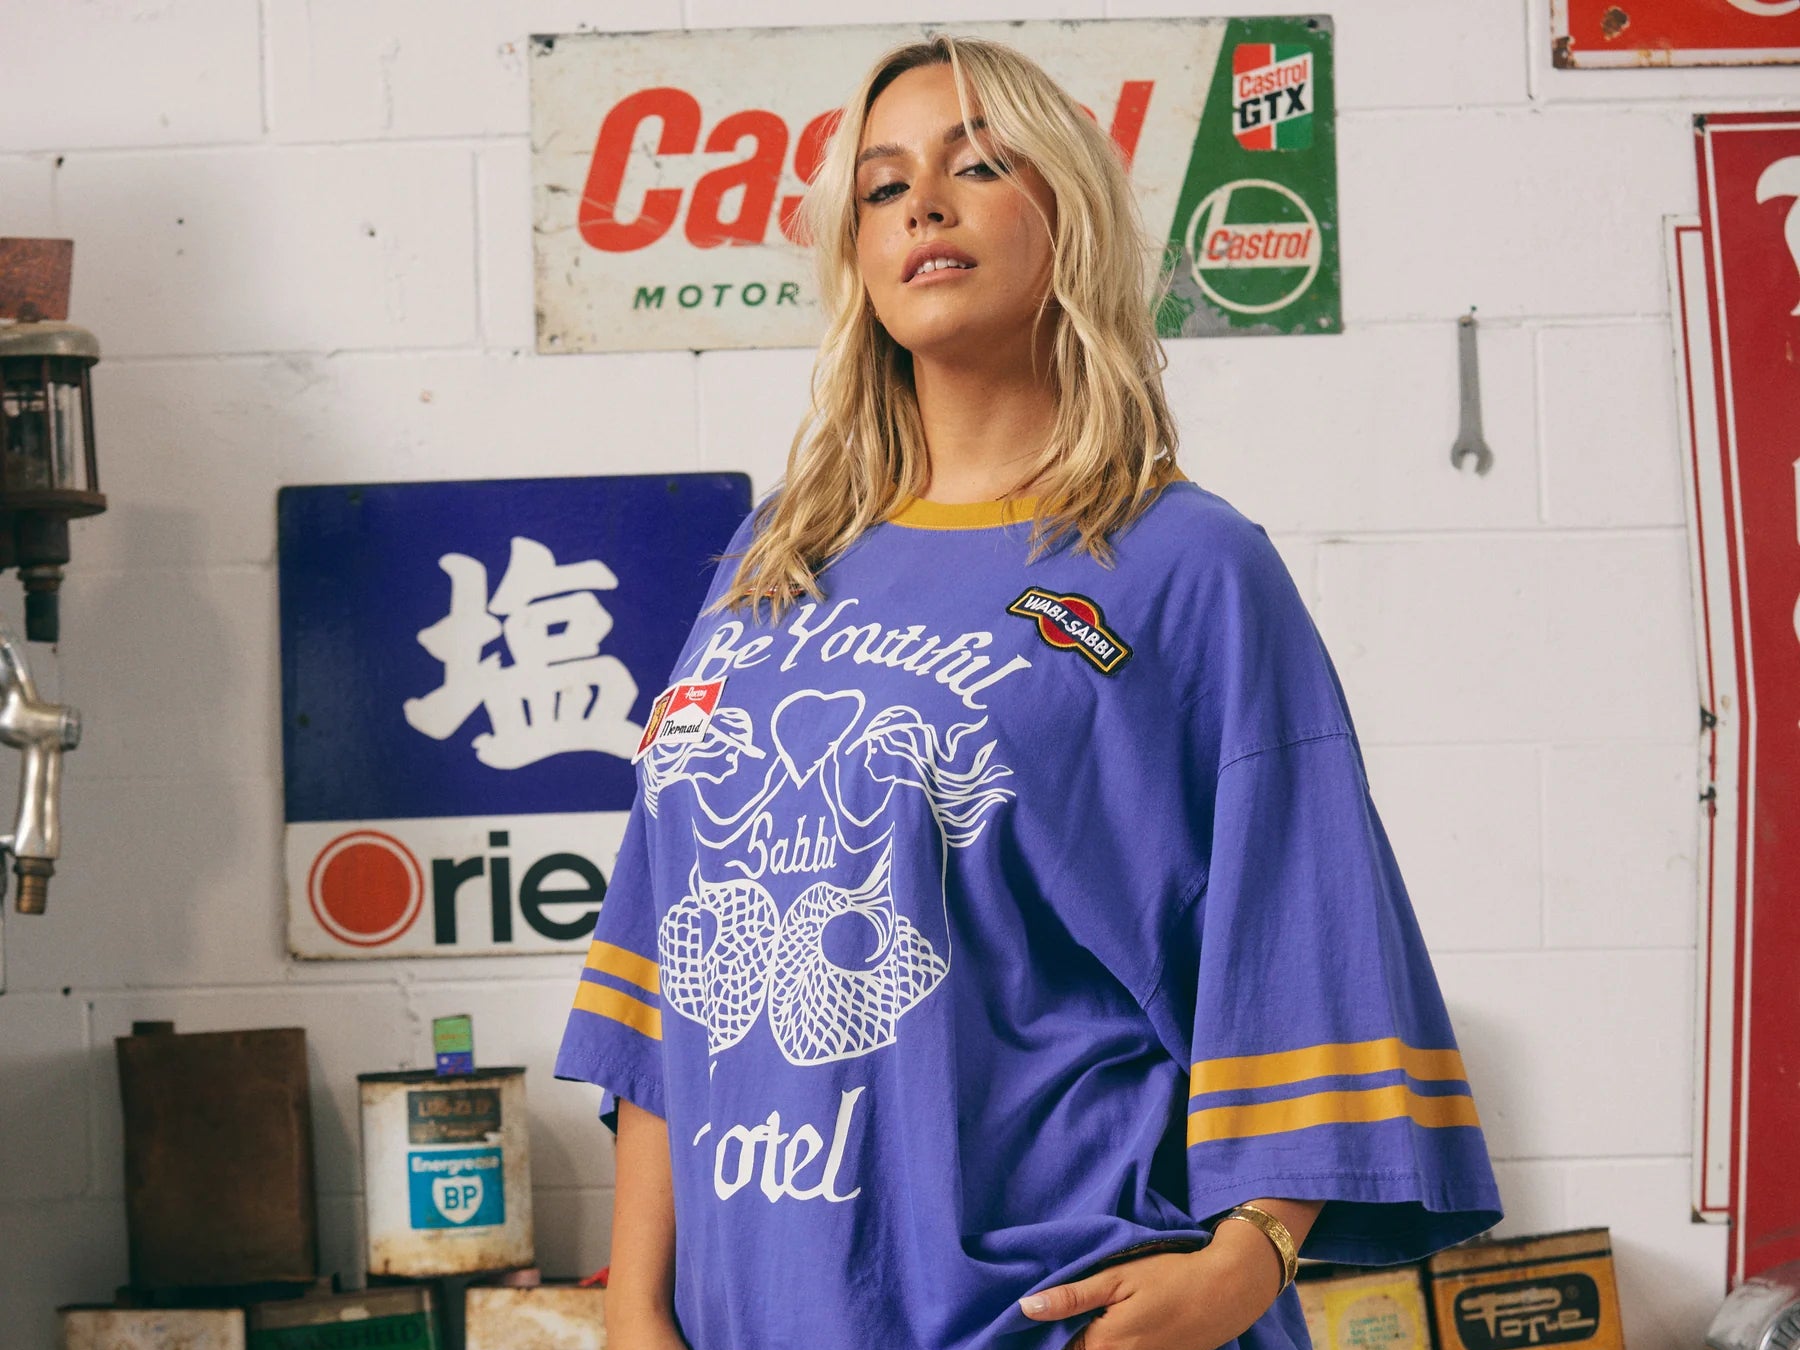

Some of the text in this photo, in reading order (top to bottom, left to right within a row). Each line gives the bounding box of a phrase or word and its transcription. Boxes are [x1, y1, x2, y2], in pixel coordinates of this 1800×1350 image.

[1238, 62, 1309, 100] Castrol
[1239, 83, 1306, 130] GTX
[1206, 228, 1314, 262] Castrol
[633, 282, 799, 310] MOTOR
[683, 620, 774, 682] Be
[1023, 595, 1116, 660] WABI-SABBI
[403, 536, 644, 770] 塩
[660, 718, 704, 738] Mermaid
[725, 814, 838, 878] Sabbi
[692, 1085, 867, 1204] otel
[442, 1185, 479, 1210] BP
